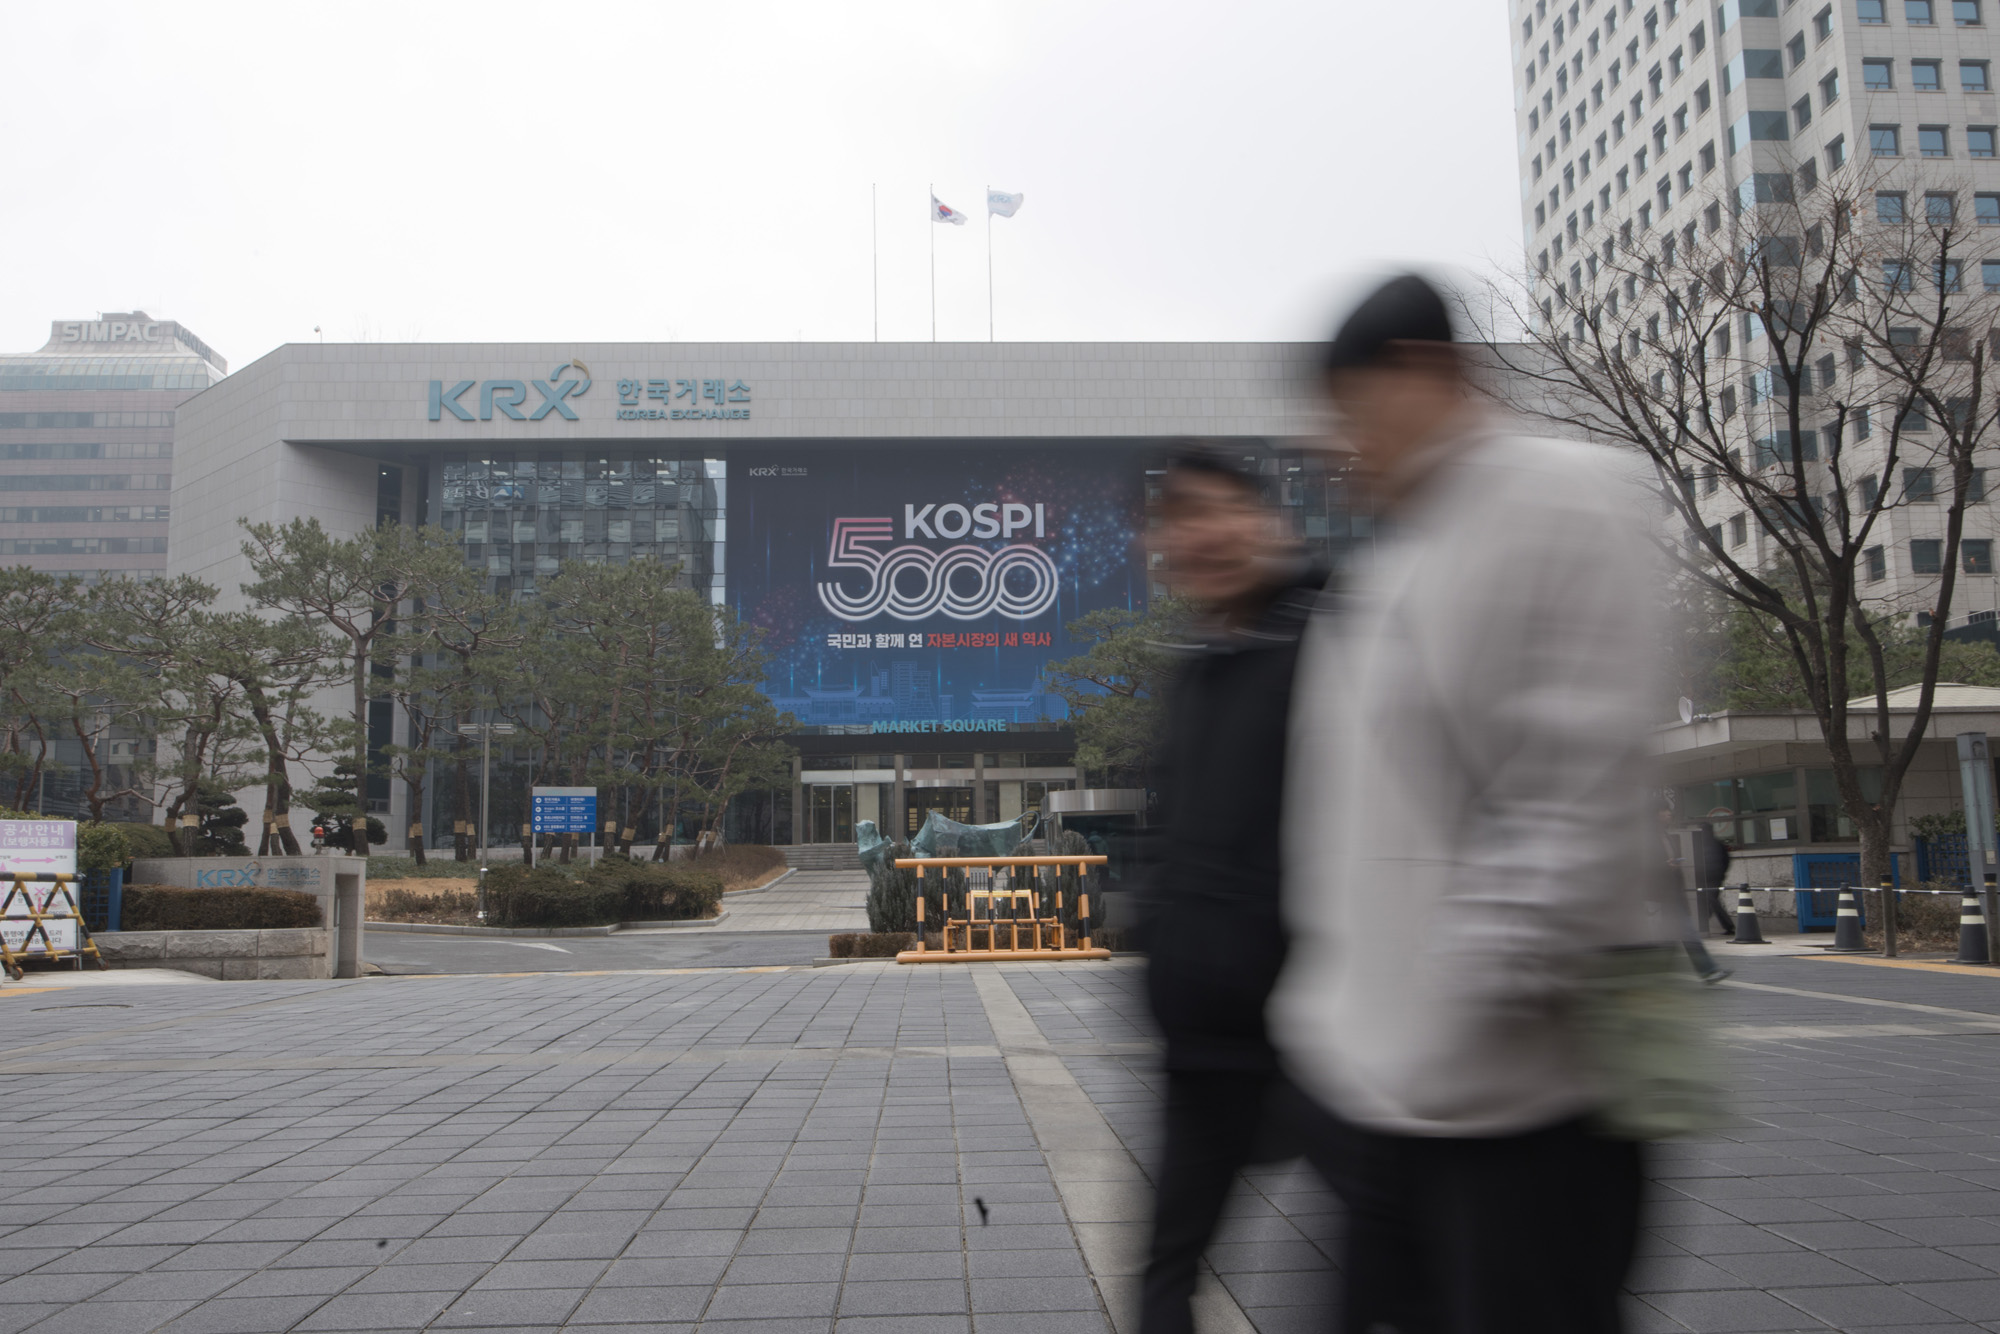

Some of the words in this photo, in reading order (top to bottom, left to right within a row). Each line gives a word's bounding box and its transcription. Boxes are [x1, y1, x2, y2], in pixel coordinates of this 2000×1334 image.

[62, 321, 161, 342] SIMPAC
[429, 370, 585, 421] KRX
[616, 378, 751, 406] 한국거래소
[616, 409, 668, 420] KOREA
[670, 409, 750, 420] EXCHANGE
[750, 466, 778, 476] KRX
[904, 503, 1045, 539] KOSPI
[817, 517, 1059, 621] 5000
[827, 633, 871, 649] 국민과
[875, 633, 905, 648] 함께
[908, 633, 923, 648] 연
[927, 632, 999, 648] 자본시장의
[1003, 632, 1018, 647] 새
[1022, 632, 1052, 647] 역사
[873, 720, 938, 734] MARKET
[943, 719, 1007, 732] SQUARE
[3, 823, 64, 837] 공사안내
[197, 866, 258, 887] KRX
